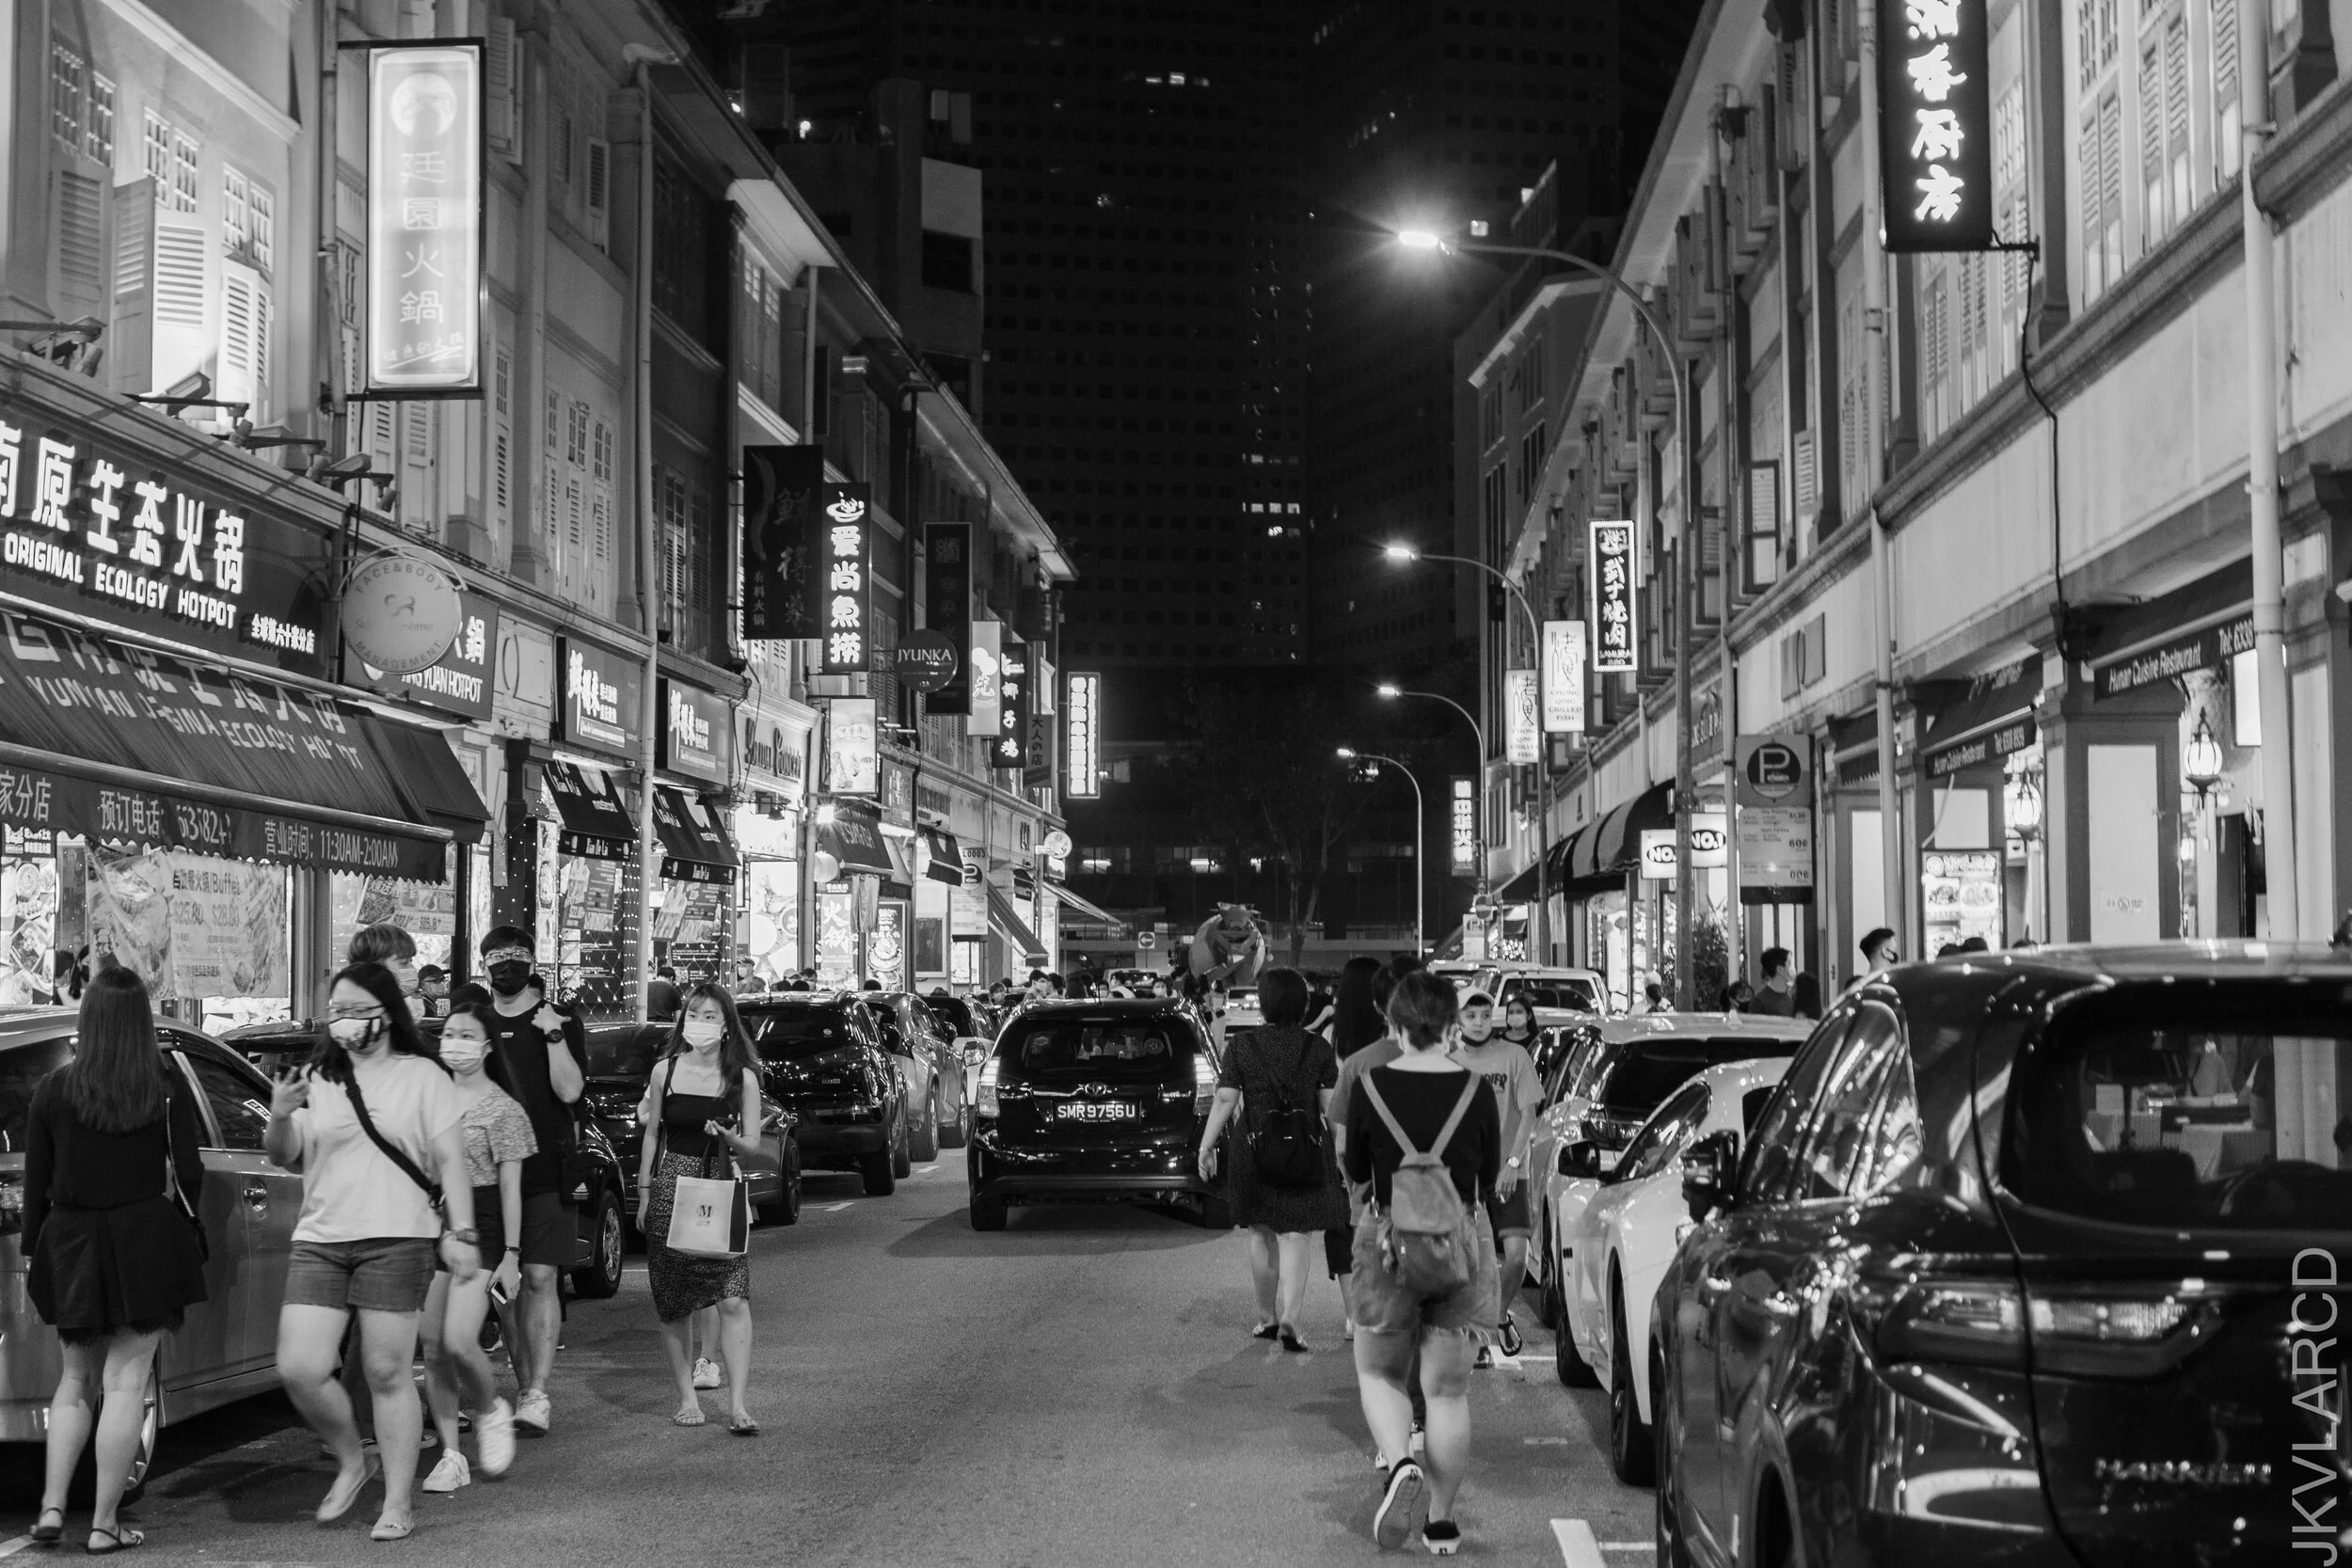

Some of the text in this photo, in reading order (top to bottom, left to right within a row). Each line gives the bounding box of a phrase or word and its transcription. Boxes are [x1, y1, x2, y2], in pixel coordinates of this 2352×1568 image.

[5, 532, 236, 629] ORIGINAL ECOLOGY HOTPOT
[898, 648, 952, 663] JYUNKA
[1759, 747, 1790, 784] P
[1057, 1104, 1136, 1118] SMR9756U
